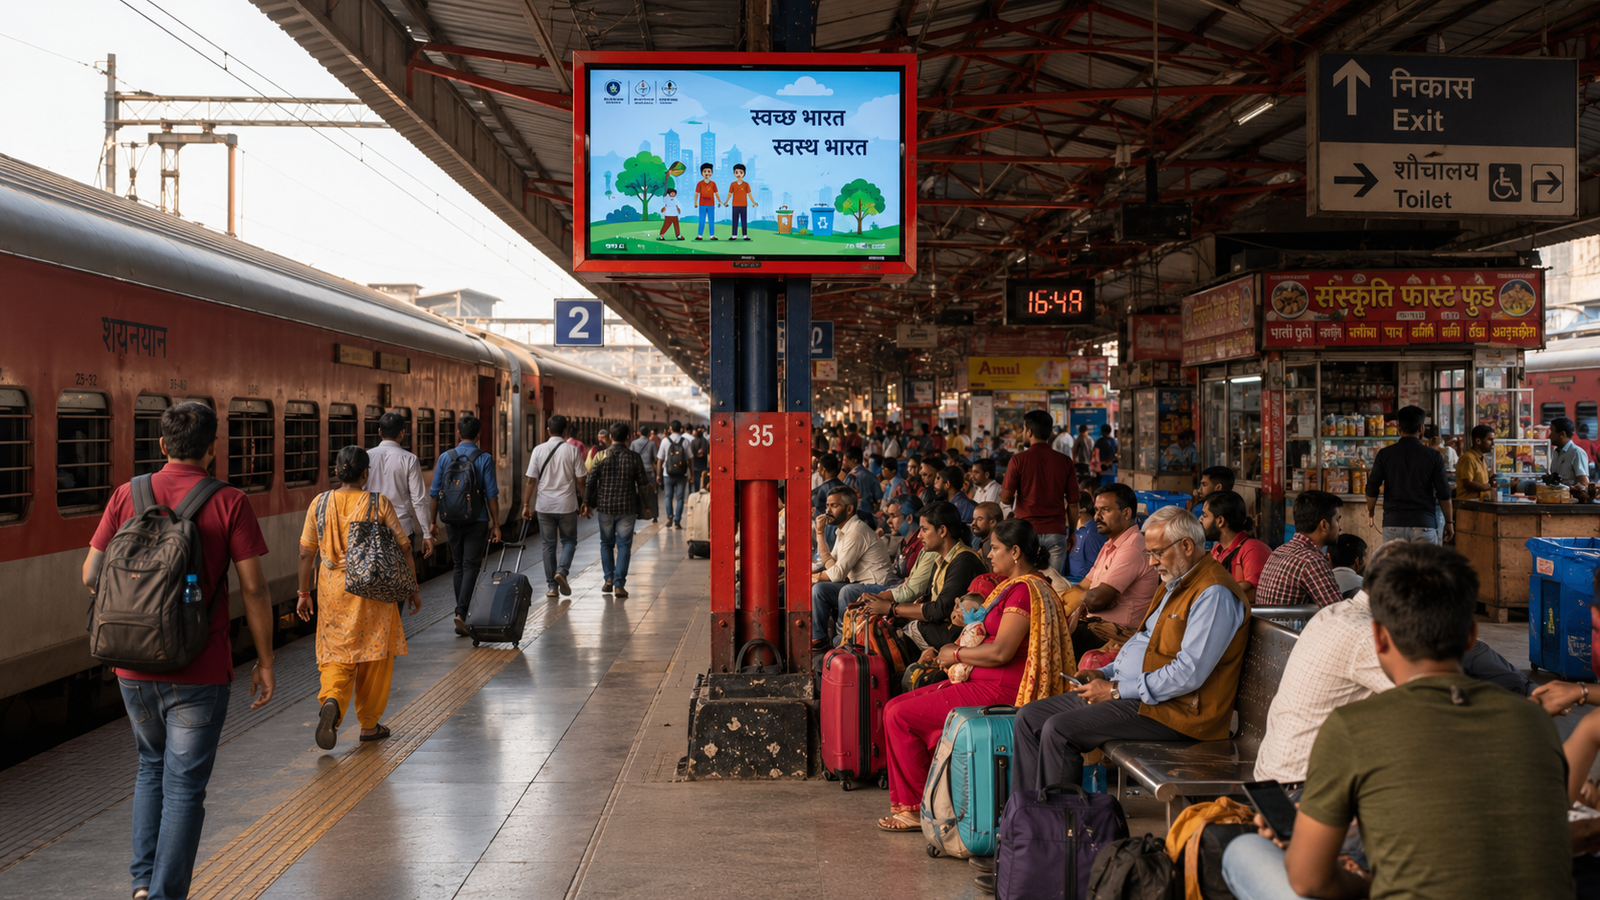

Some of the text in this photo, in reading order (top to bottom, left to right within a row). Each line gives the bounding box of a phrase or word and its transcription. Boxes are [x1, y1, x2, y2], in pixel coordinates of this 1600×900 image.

[1390, 67, 1475, 99] निकास
[750, 109, 846, 127] स्वच्छ भारत
[1393, 109, 1443, 132] Exit
[772, 138, 869, 156] स्वस्थ भारत
[1393, 153, 1480, 181] शौचालय
[1394, 189, 1452, 209] Toilet
[569, 306, 590, 339] 2
[101, 316, 168, 359] शयनयान
[978, 360, 1021, 375] Amul
[75, 372, 98, 387] 25-32
[748, 424, 774, 448] 35
